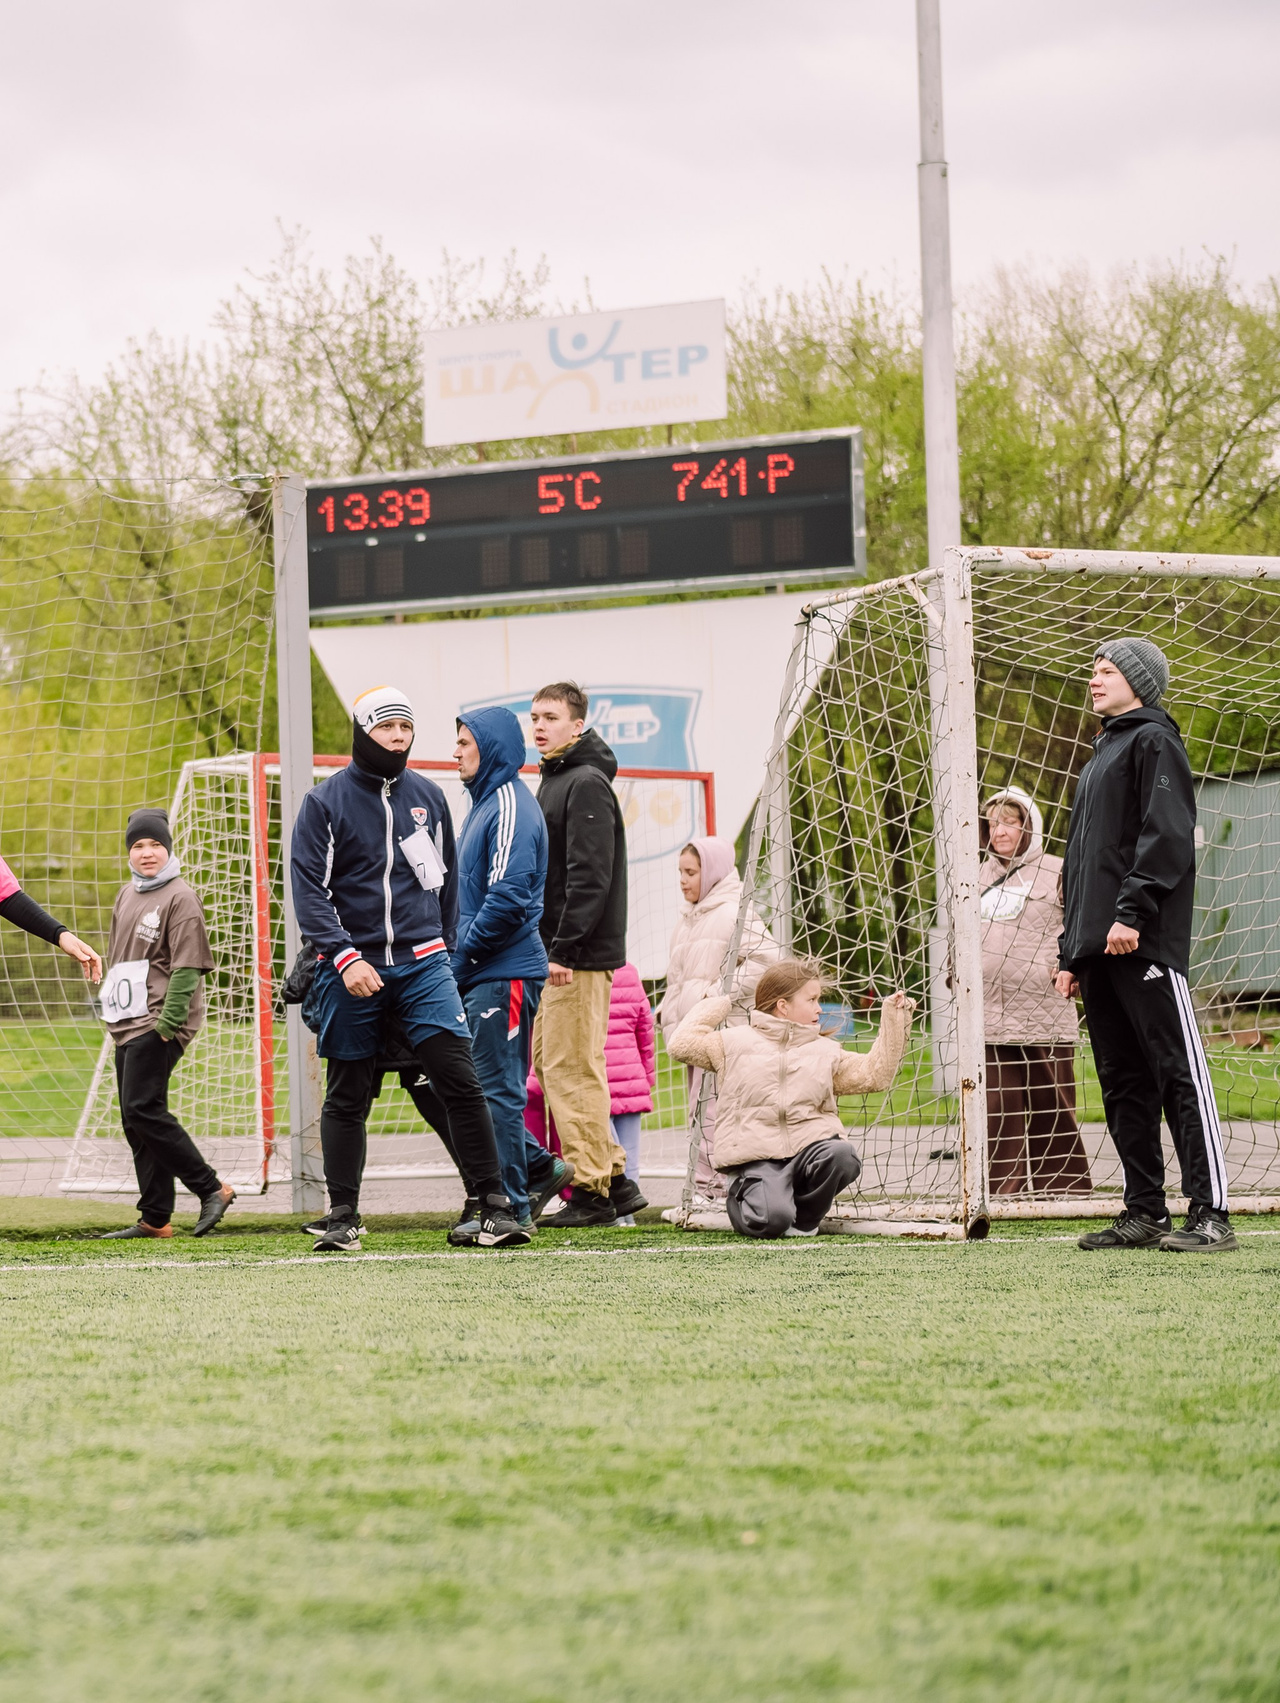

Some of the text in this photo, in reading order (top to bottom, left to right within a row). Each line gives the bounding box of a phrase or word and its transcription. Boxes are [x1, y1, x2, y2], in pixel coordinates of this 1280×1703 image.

[317, 487, 431, 533] 13.39
[672, 456, 747, 502] 741
[108, 978, 132, 1012] 40
